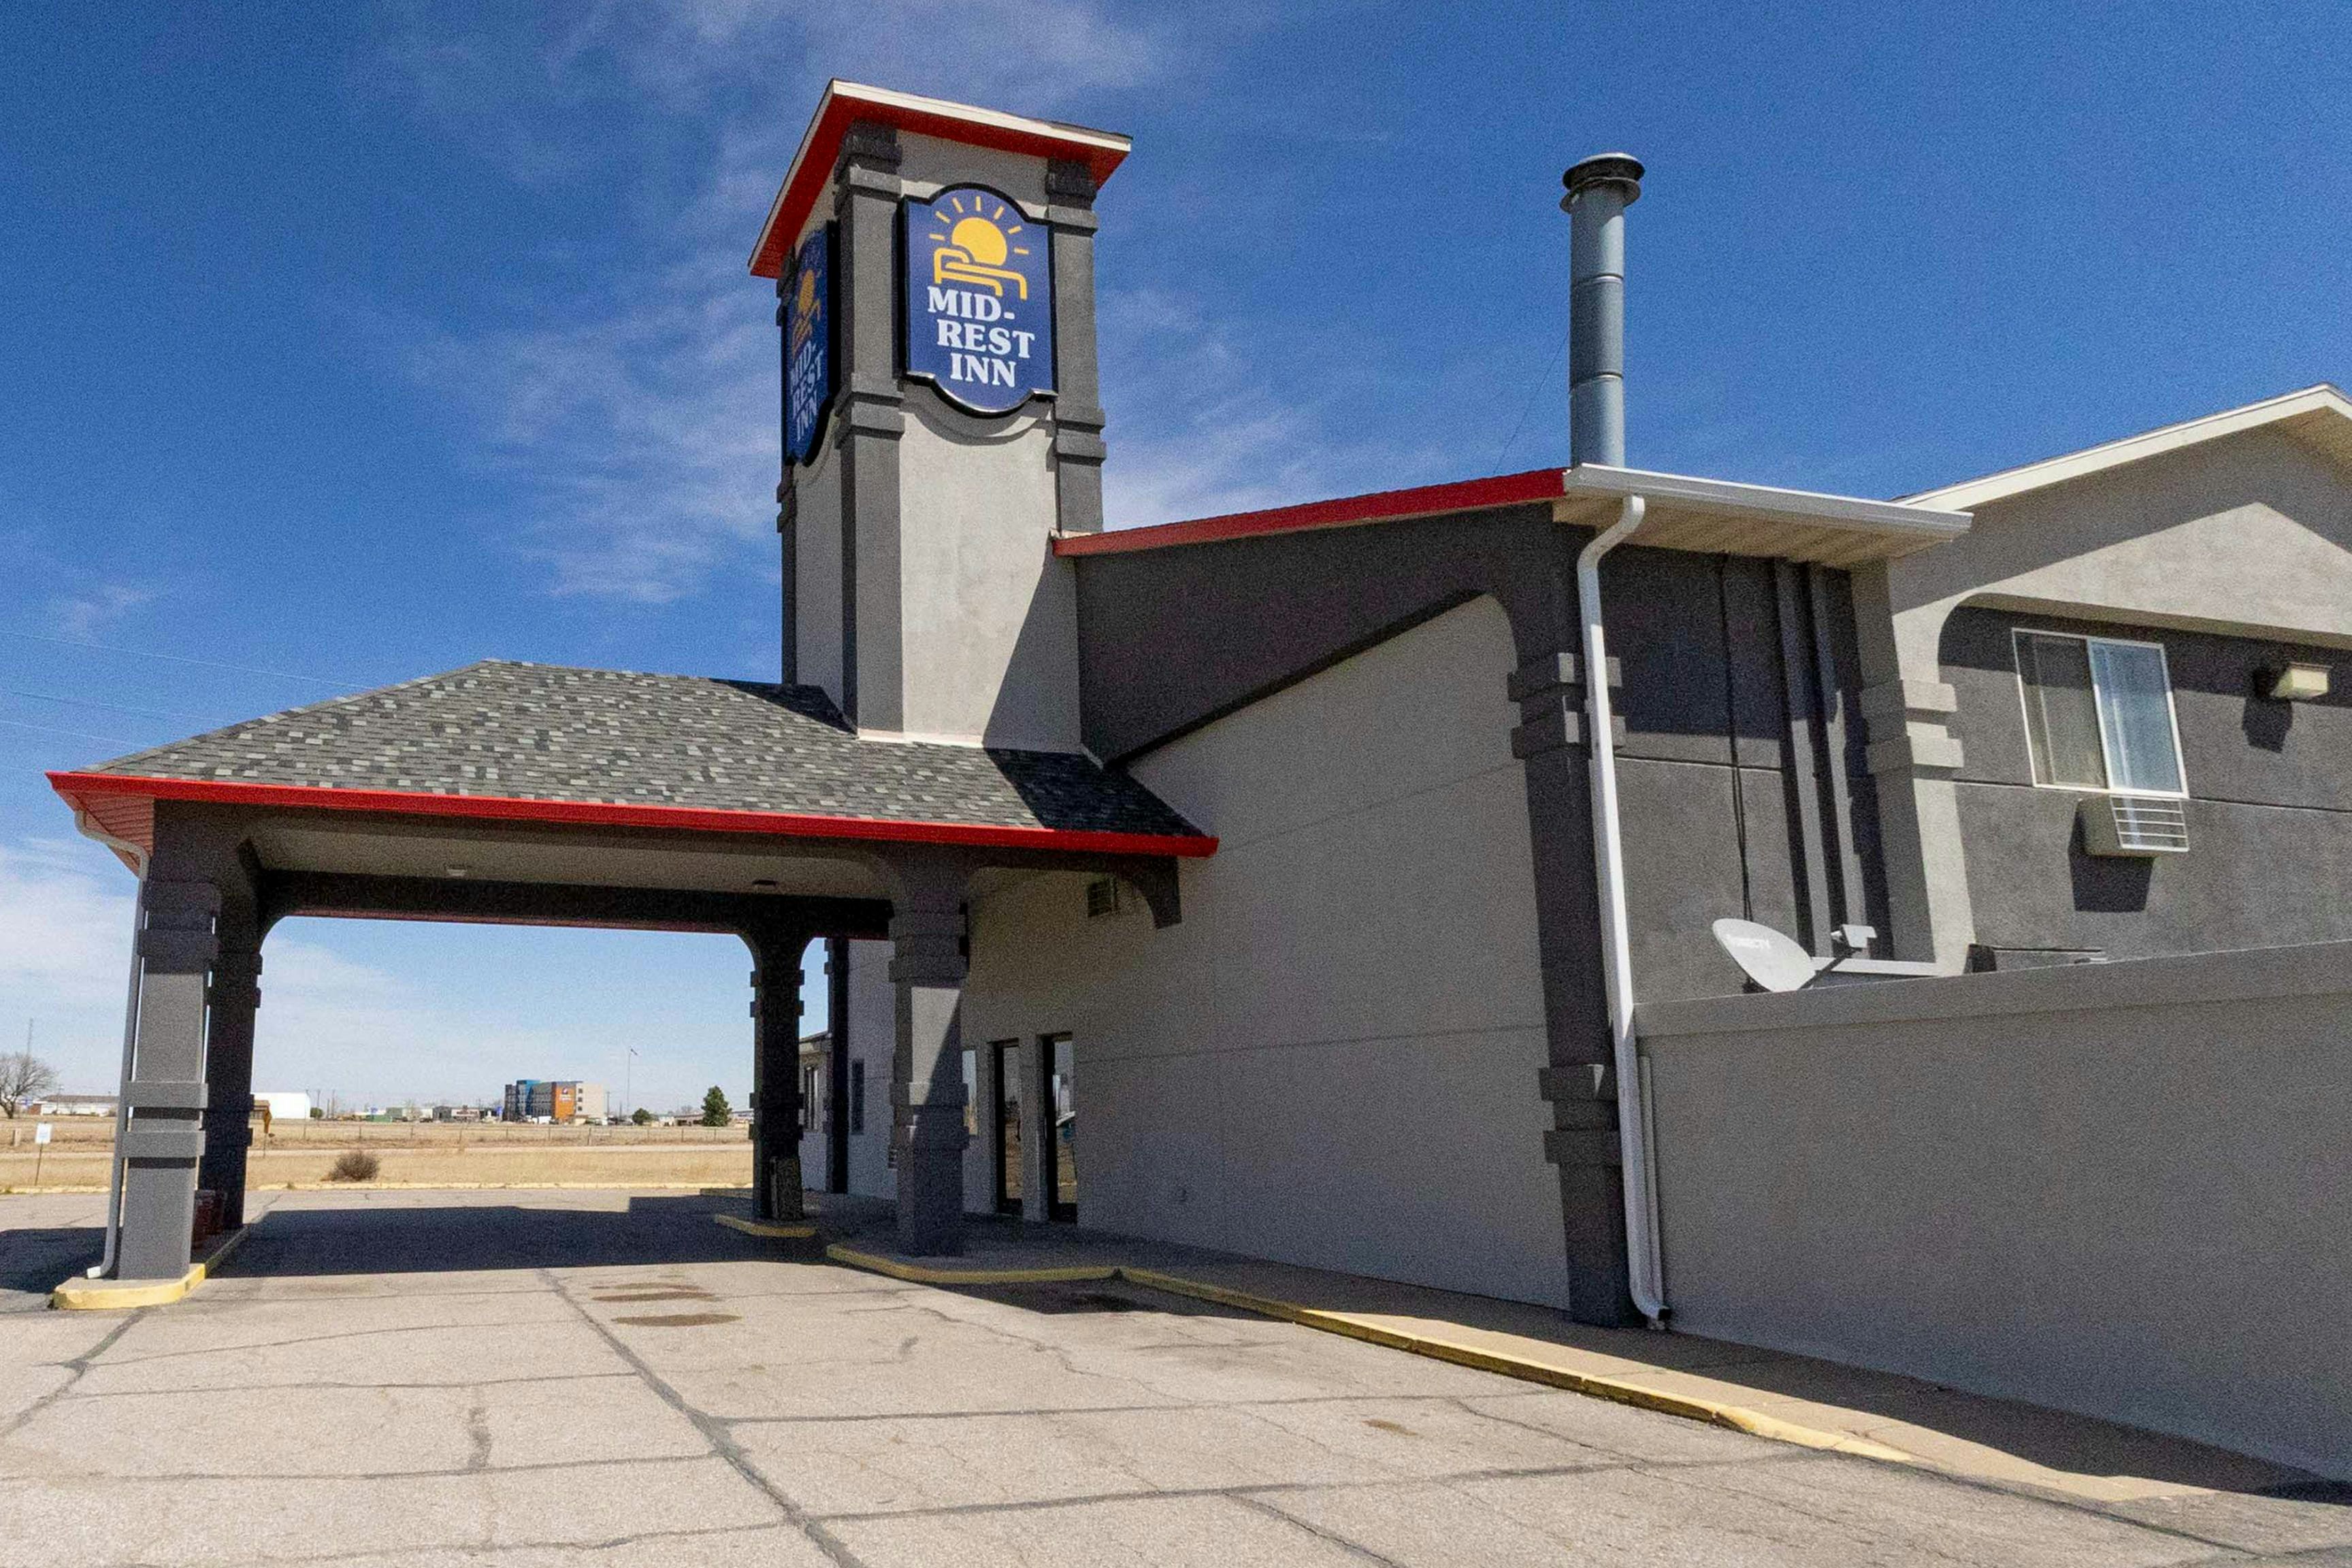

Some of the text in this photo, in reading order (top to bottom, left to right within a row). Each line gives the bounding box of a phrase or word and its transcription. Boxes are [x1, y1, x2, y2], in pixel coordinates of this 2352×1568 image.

[928, 287, 1015, 321] MID-
[937, 320, 1034, 358] REST
[791, 341, 816, 394] MID-
[794, 350, 823, 419] REST
[951, 353, 1016, 387] INN
[796, 390, 817, 442] INN
